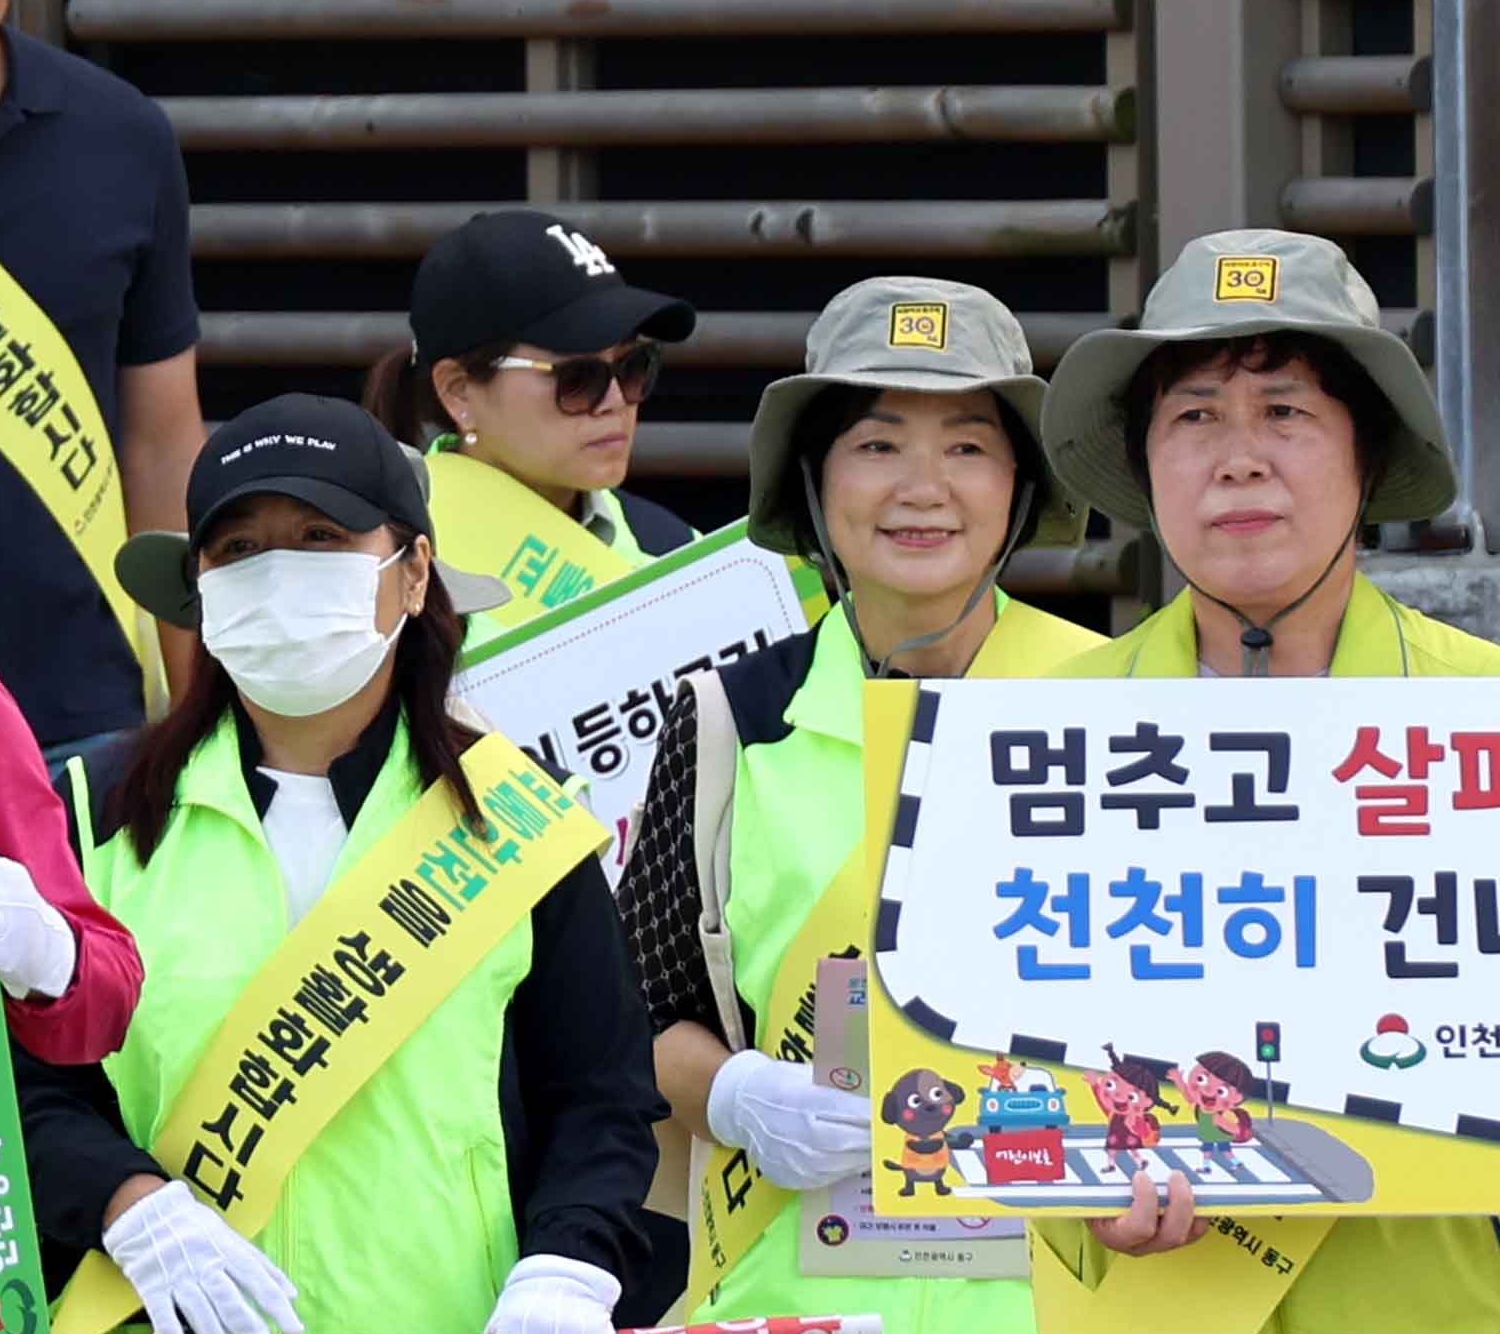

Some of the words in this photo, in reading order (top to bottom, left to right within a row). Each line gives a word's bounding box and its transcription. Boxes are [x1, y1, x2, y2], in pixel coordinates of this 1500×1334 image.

[546, 224, 615, 277] LA
[254, 434, 281, 447] WHY
[284, 434, 304, 445] WE
[307, 437, 337, 451] PLAY
[989, 721, 1300, 837] 멈추고
[379, 761, 576, 948] 교통안전을
[993, 867, 1318, 981] 천천히
[184, 929, 405, 1210] 생활화합시다
[1267, 1246, 1294, 1276] 동구
